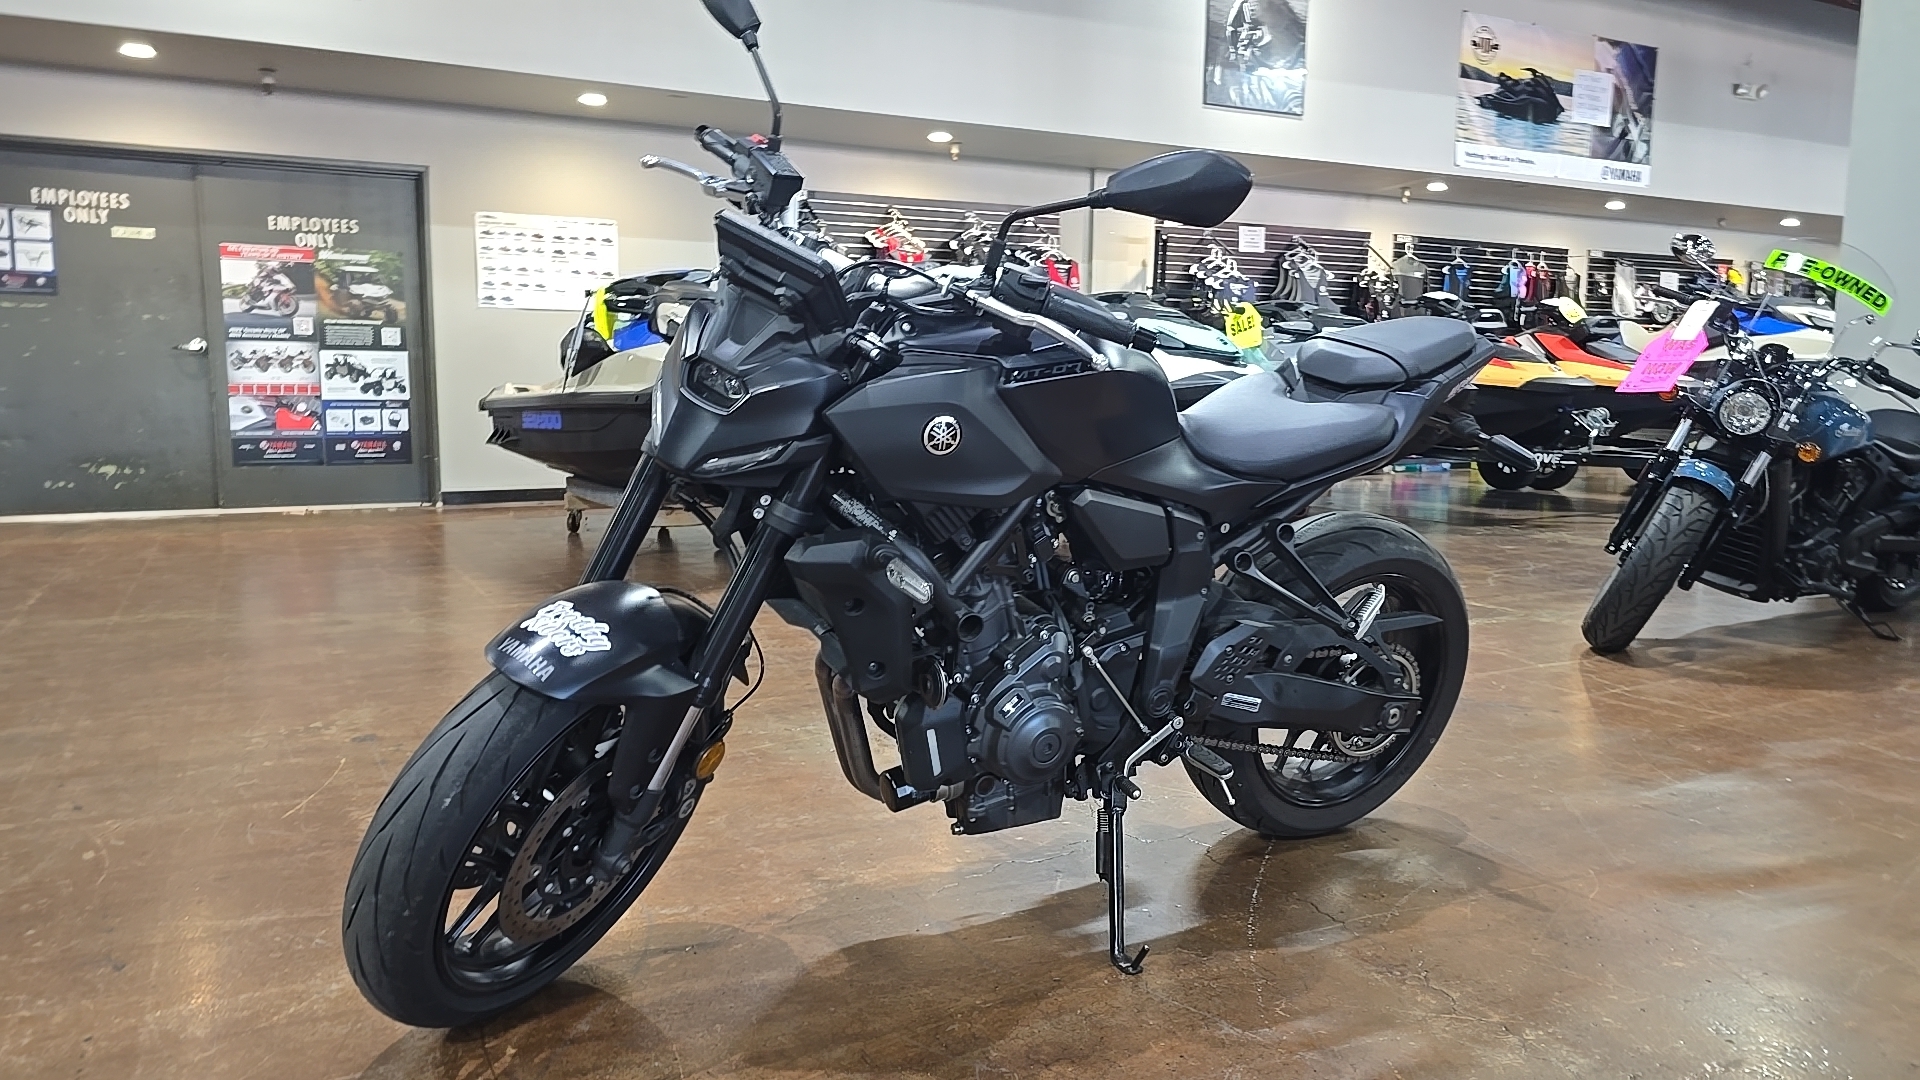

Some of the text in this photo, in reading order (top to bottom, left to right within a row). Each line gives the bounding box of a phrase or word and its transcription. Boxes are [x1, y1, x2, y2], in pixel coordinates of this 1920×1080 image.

[30, 187, 131, 209] EMPLOYEES
[63, 206, 109, 224] ONLY
[267, 215, 360, 234] EMPLOYEES
[295, 232, 336, 248] ONLY
[1772, 252, 1888, 309] PE-OWNED
[1230, 315, 1256, 337] SALE!
[1010, 361, 1083, 381] MT-07
[1534, 452, 1565, 464] OVE
[497, 636, 556, 683] YAMAHA
